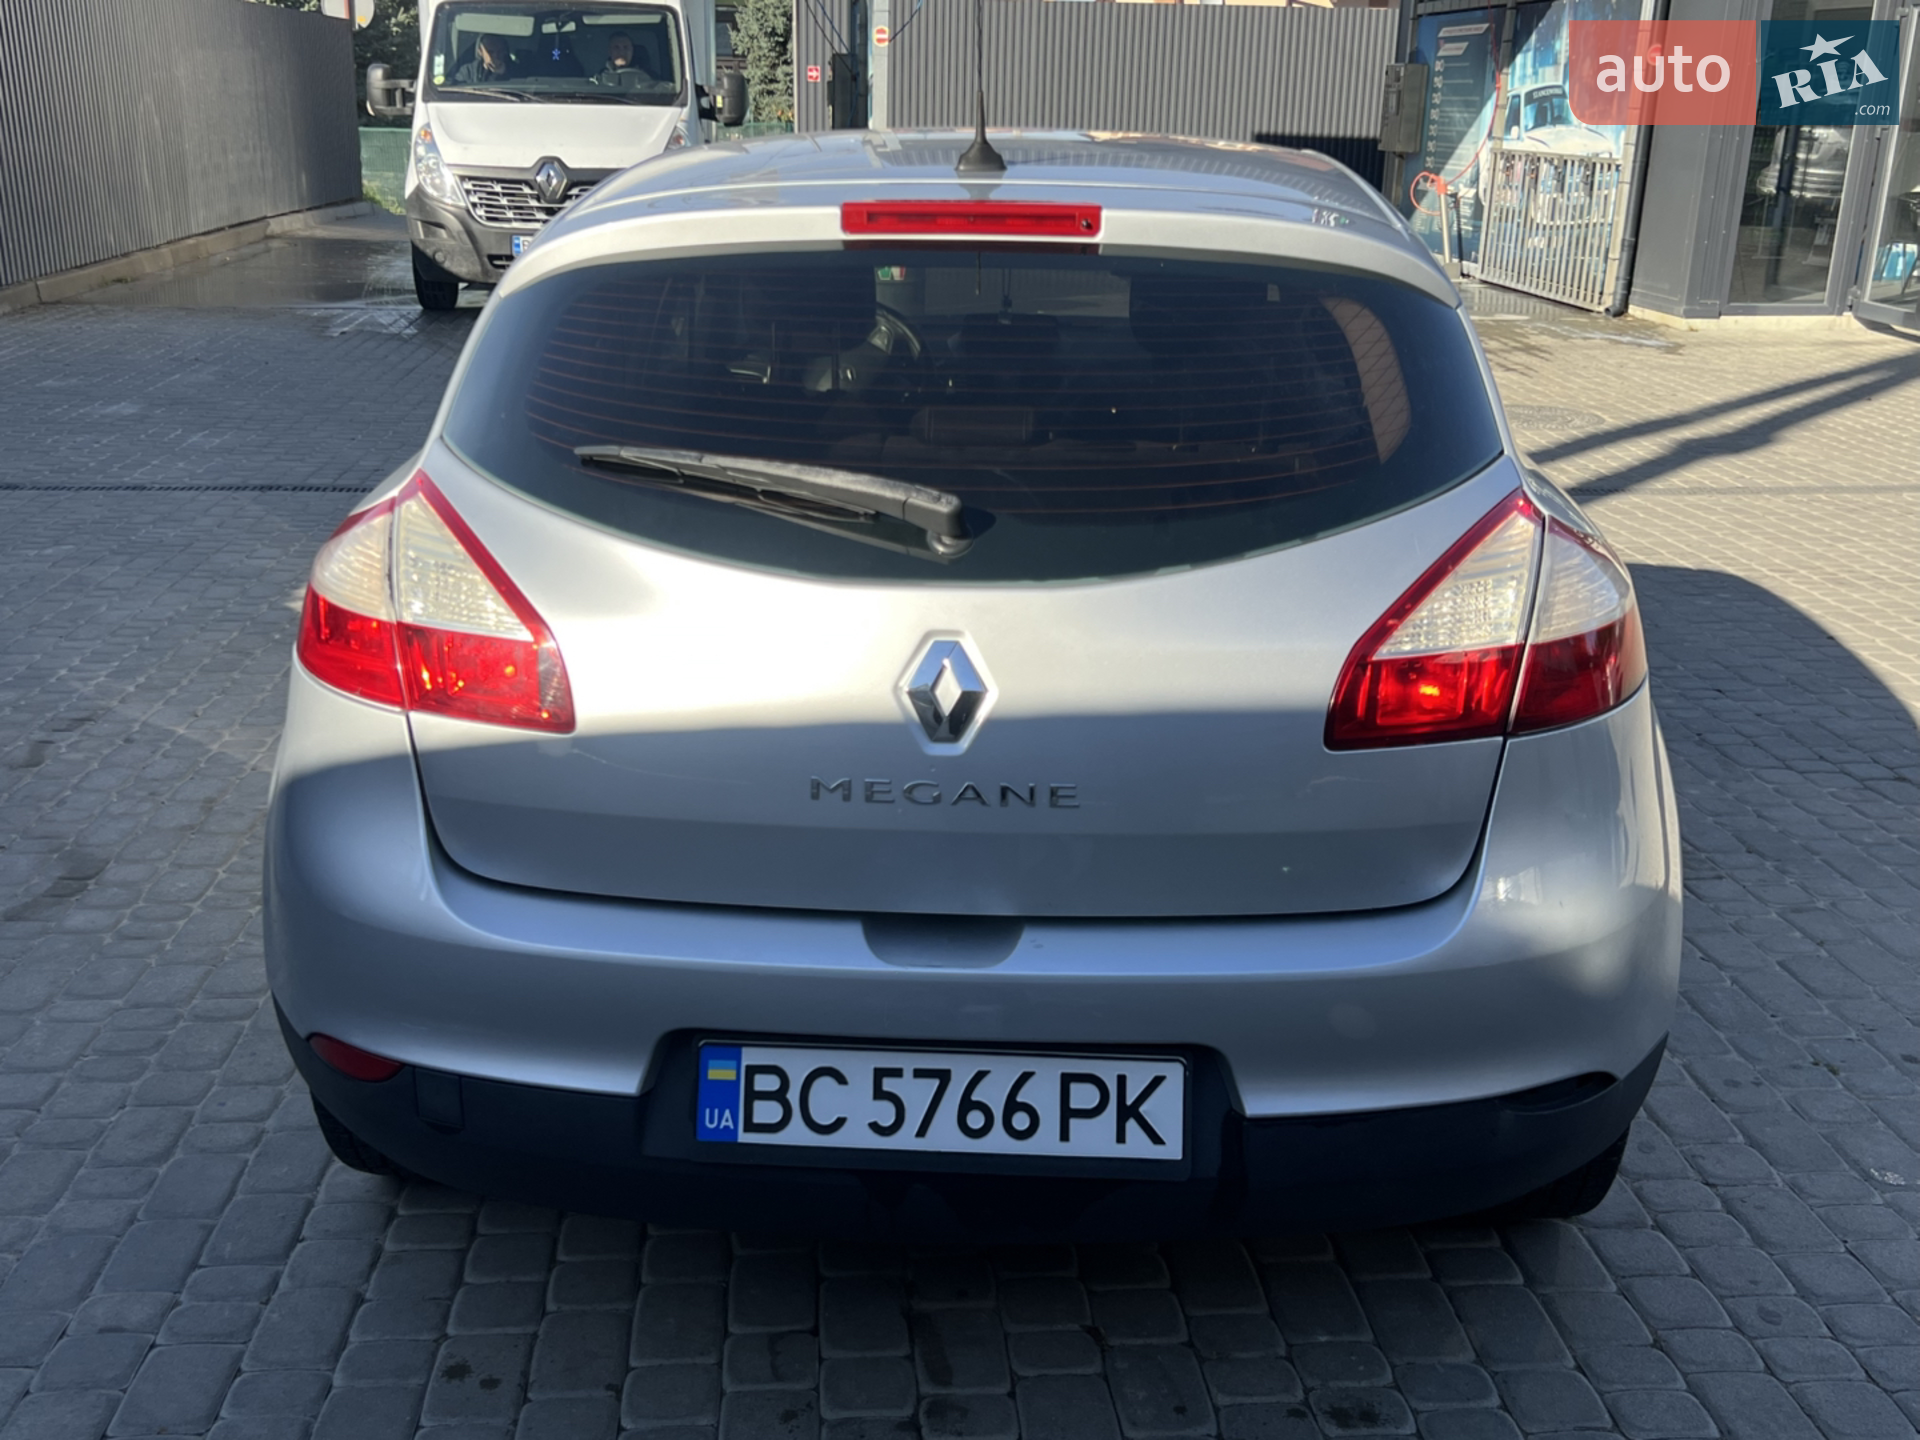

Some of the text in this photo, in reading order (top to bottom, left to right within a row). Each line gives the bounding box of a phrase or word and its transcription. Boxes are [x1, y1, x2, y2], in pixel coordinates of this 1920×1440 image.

[810, 775, 1081, 808] MEGANE
[705, 1108, 734, 1129] UA
[742, 1064, 1167, 1146] BC 5766 PK
